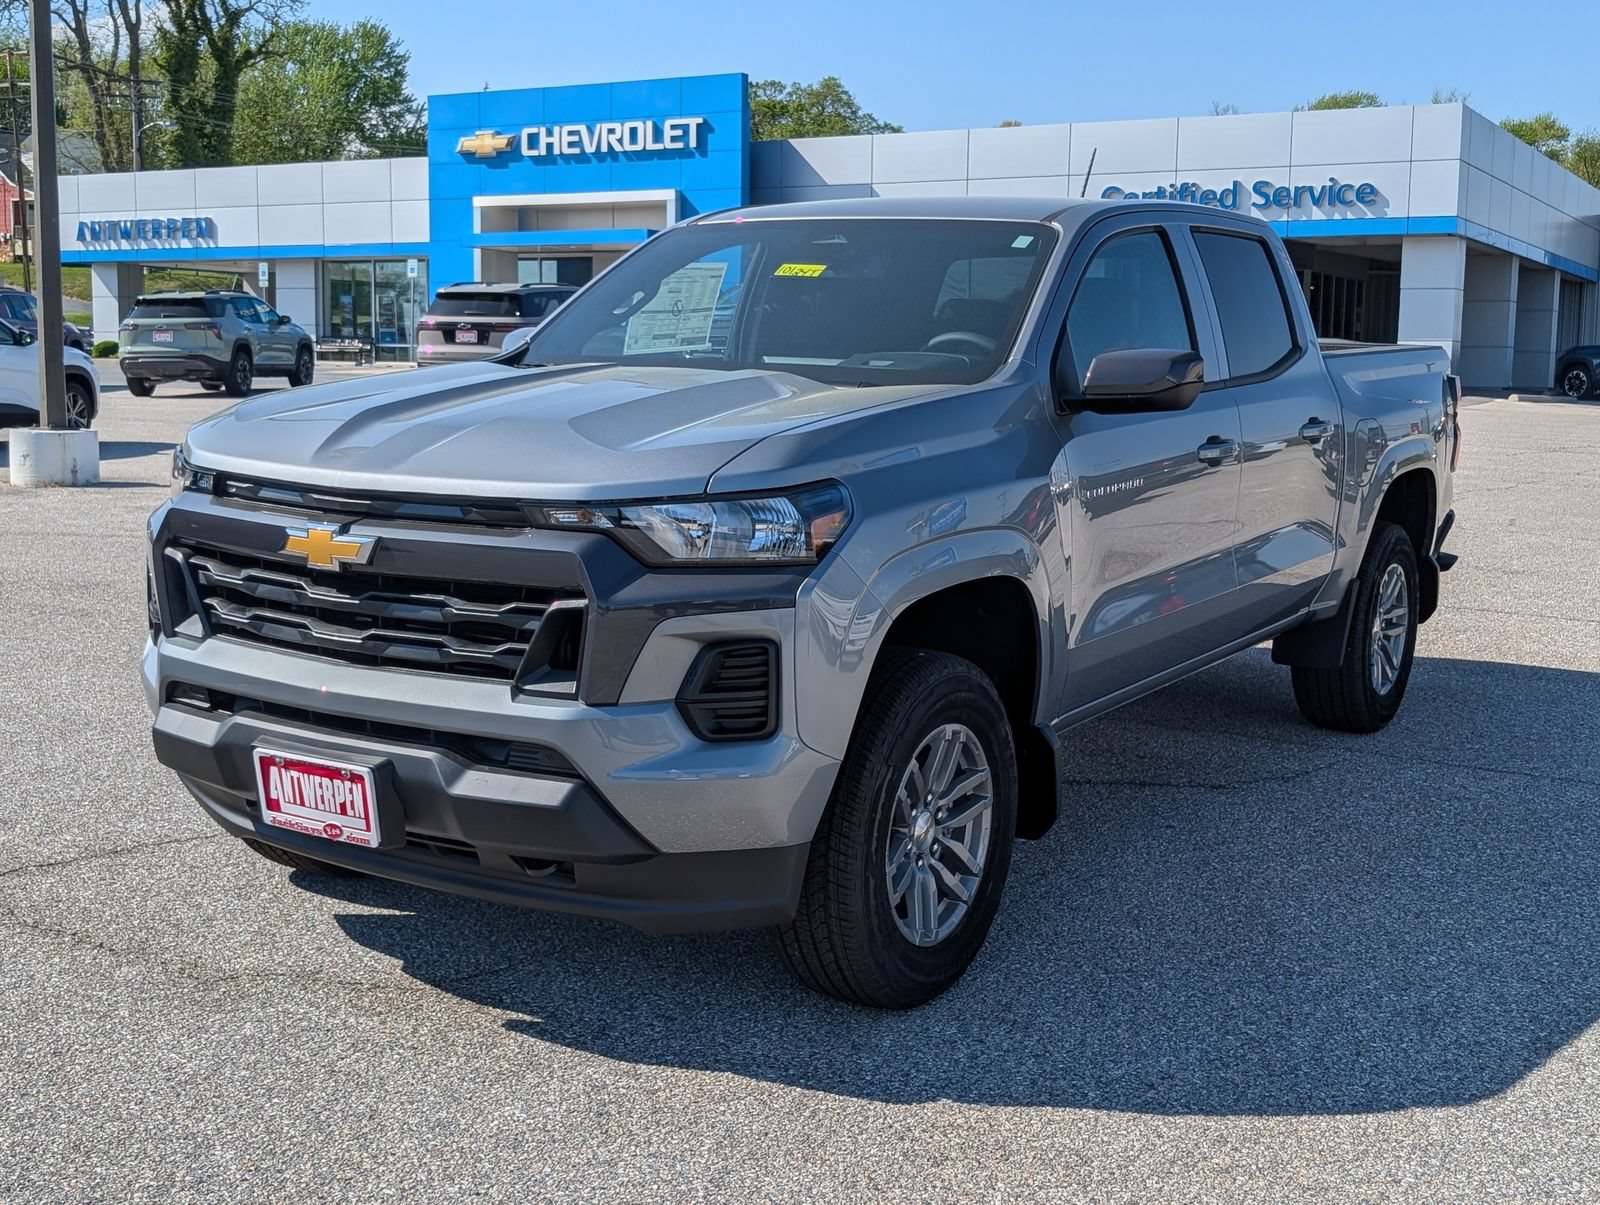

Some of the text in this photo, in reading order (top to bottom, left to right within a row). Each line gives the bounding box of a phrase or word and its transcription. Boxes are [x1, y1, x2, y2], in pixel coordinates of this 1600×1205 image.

[521, 117, 704, 157] CHEVROLET
[1250, 177, 1377, 209] Service
[76, 216, 214, 241] ANTWERPEN
[269, 766, 365, 818] ANTWERPEN
